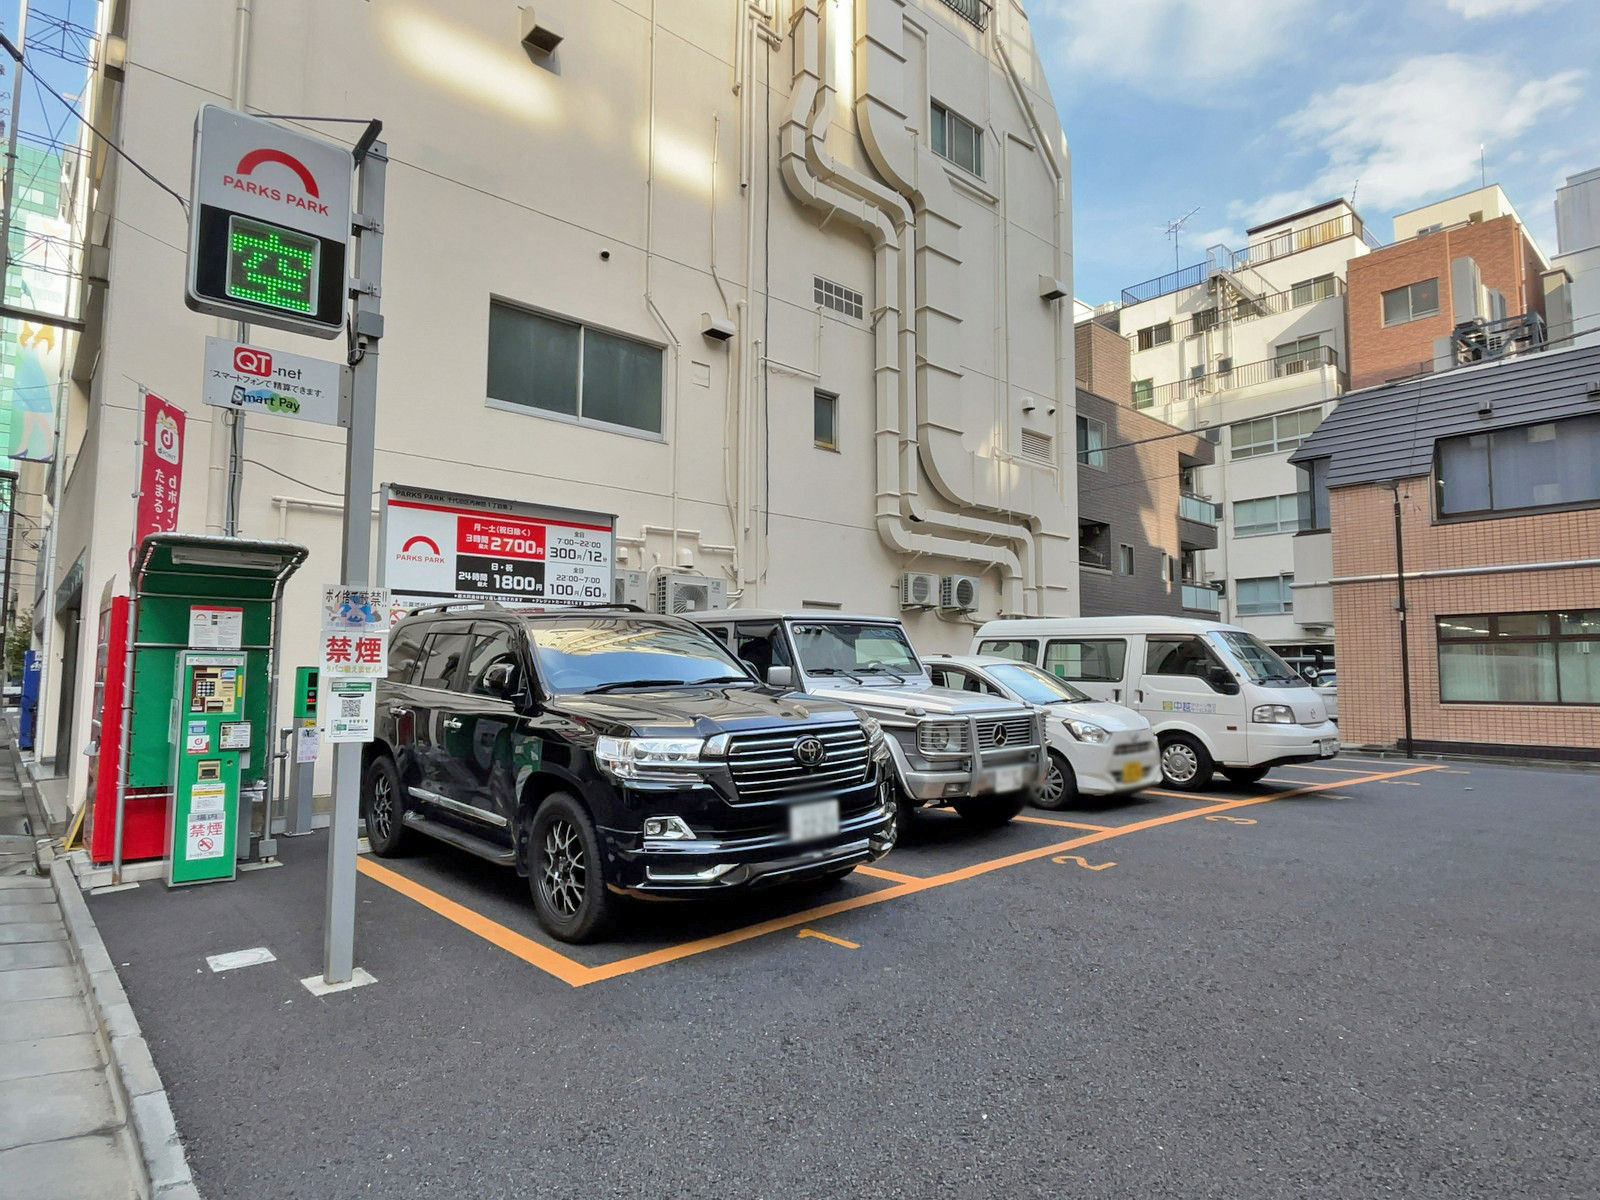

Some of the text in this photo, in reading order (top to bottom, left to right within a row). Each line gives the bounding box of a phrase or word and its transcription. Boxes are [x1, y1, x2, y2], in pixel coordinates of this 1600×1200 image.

[223, 175, 329, 217] PARKS PARK
[231, 234, 313, 312] 空
[233, 387, 300, 413] Smart Pay
[395, 489, 445, 502] PARKS PARK
[396, 553, 445, 564] PARKS PARK
[325, 635, 382, 663] 禁煙
[190, 821, 223, 837] 禁煙
[1052, 855, 1118, 871] 2
